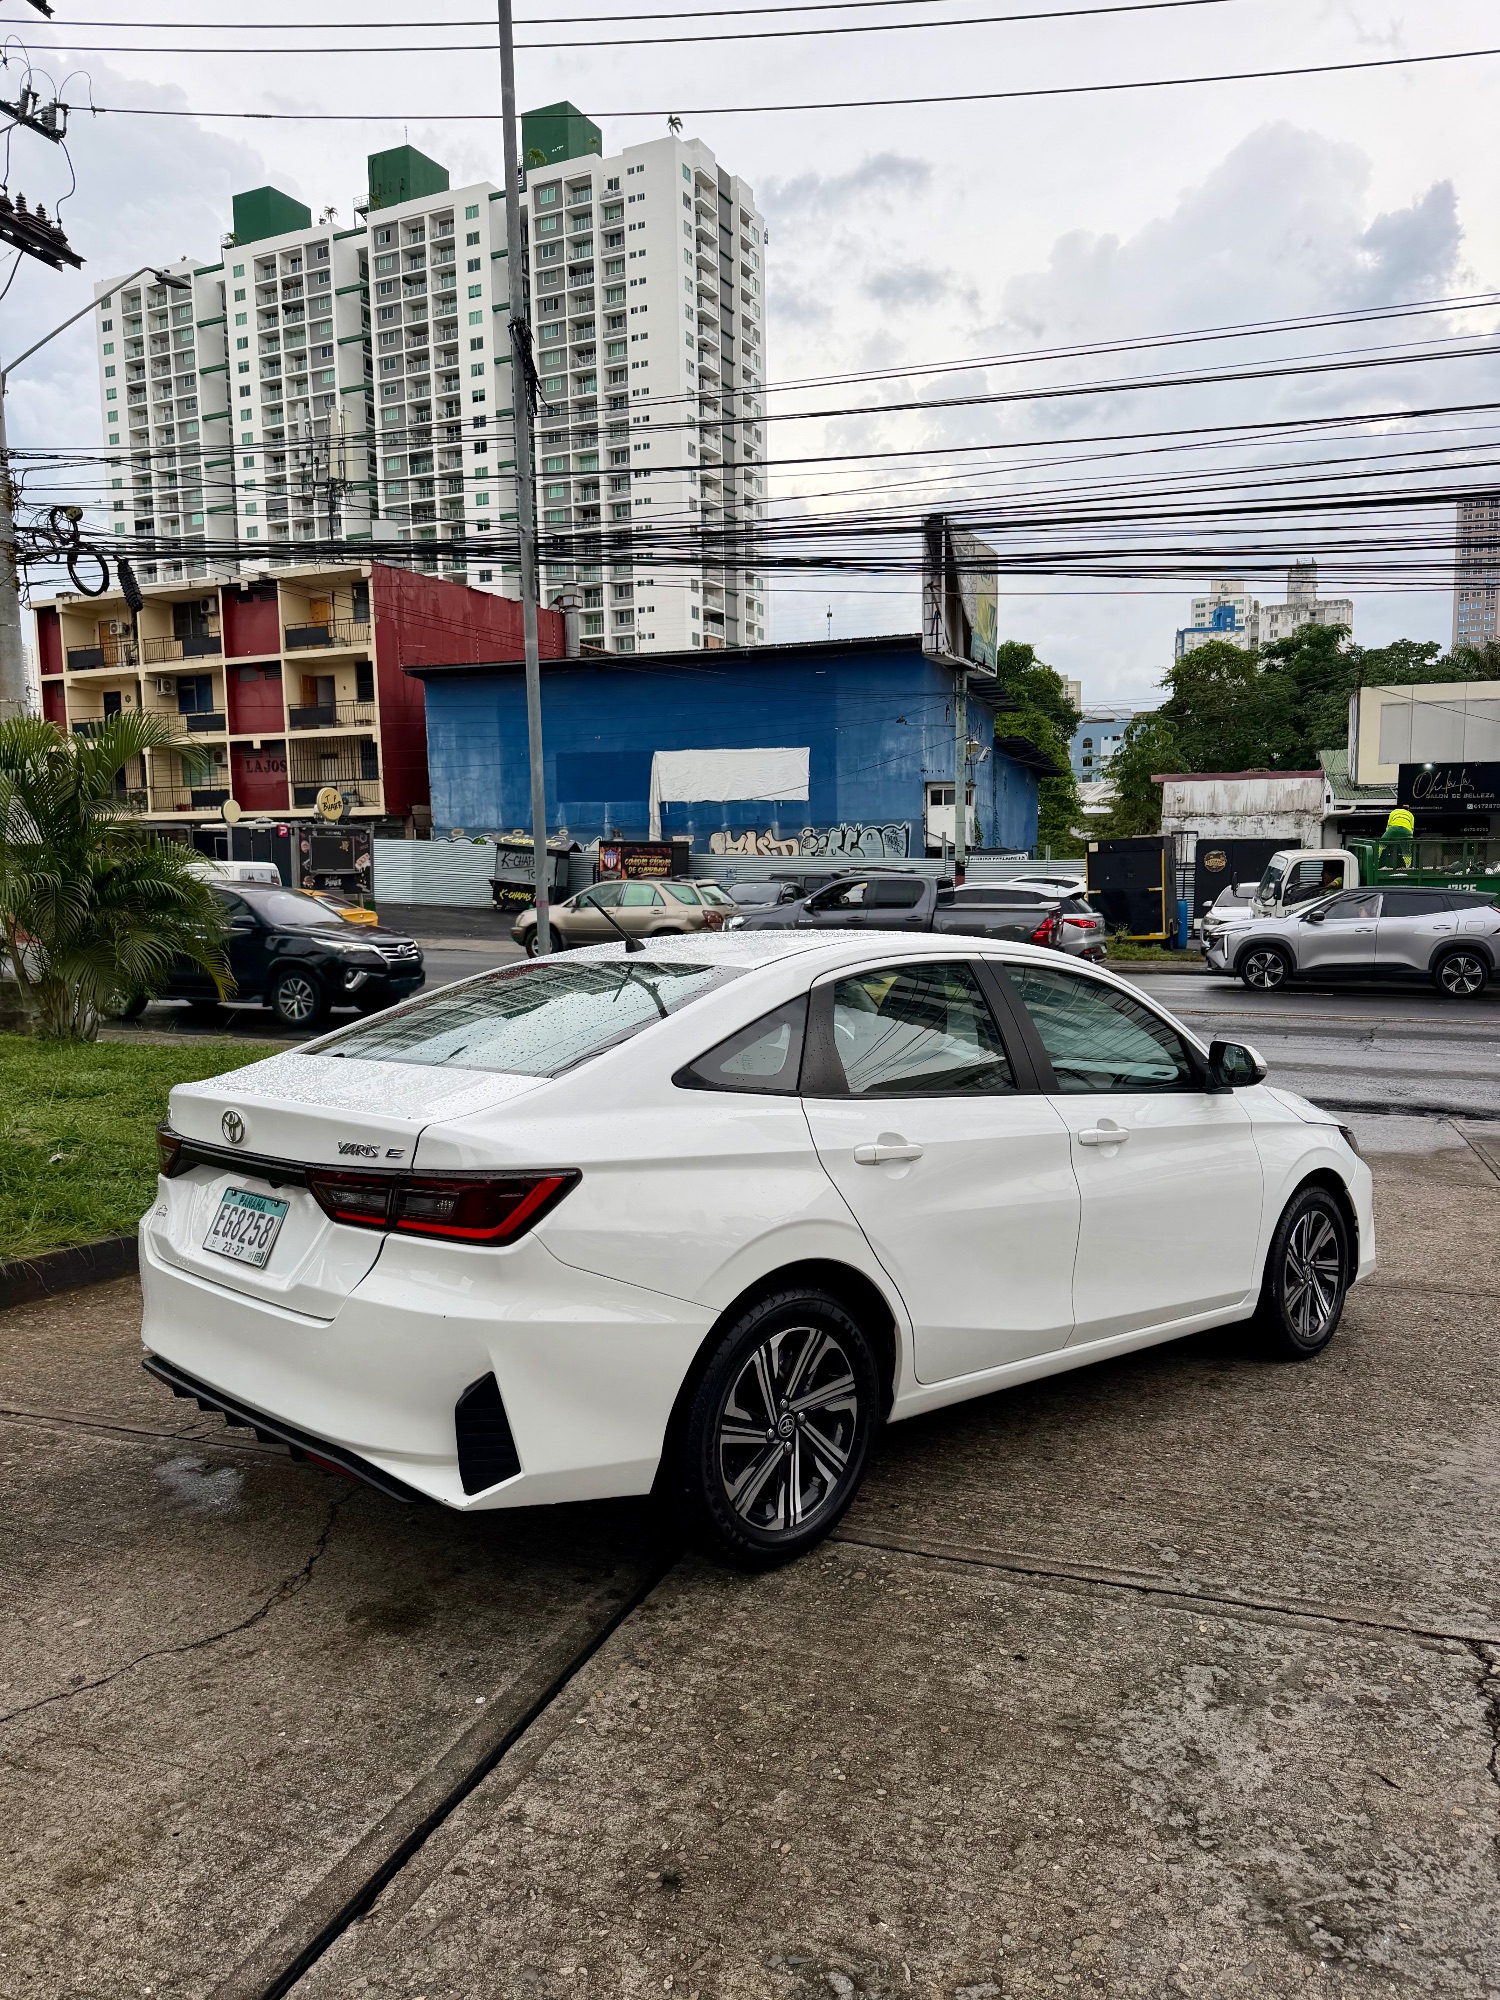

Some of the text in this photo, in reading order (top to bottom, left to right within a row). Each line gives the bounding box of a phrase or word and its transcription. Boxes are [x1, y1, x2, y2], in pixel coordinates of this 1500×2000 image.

[245, 760, 287, 773] LAJOS
[628, 866, 637, 874] DE
[385, 1148, 405, 1158] E
[239, 1195, 267, 1212] PANAMA
[213, 1204, 275, 1249] EG8258
